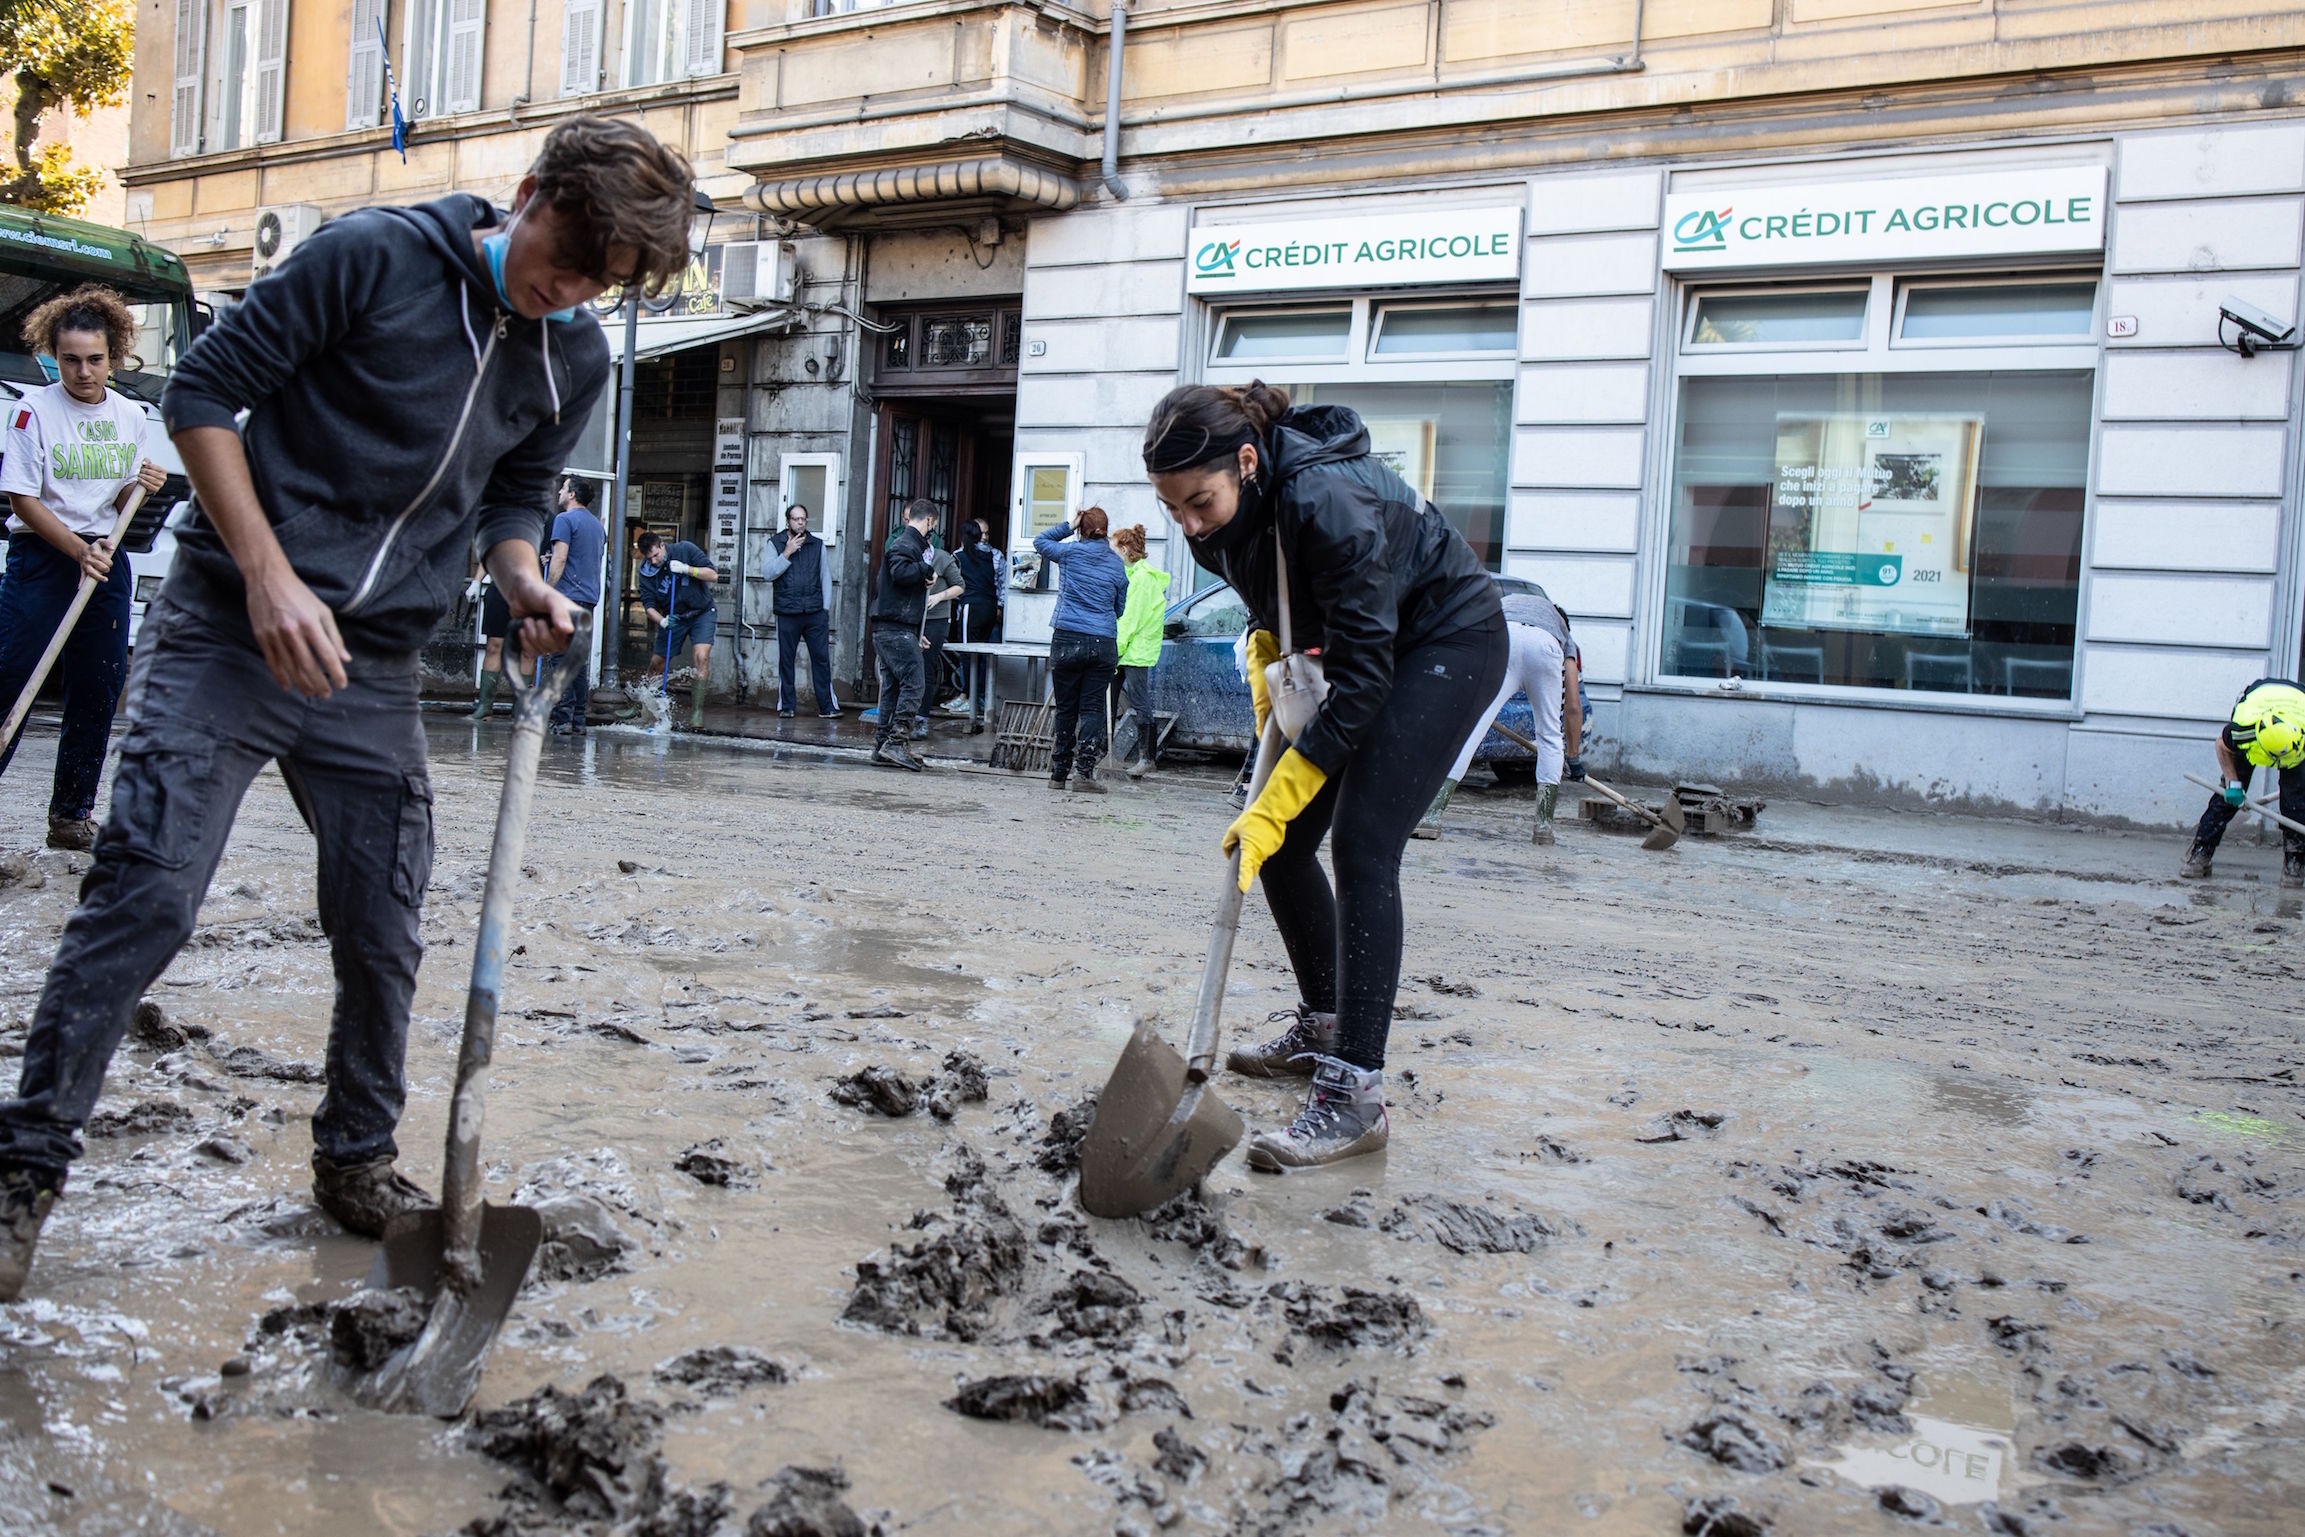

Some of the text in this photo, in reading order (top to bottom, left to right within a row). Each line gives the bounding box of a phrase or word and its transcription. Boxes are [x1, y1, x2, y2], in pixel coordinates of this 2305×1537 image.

[1739, 207, 1877, 241] CRÉDIT
[1884, 197, 2092, 232] AGRICOLE
[1245, 240, 1349, 268] CRÉDIT
[1354, 233, 1509, 263] AGRICOLE
[1781, 465, 1815, 479] Scegli
[1818, 467, 1841, 480] oggi
[1856, 467, 1893, 479] Mutuo
[1780, 480, 1800, 491] che
[1803, 480, 1825, 492] inizi
[1840, 483, 1880, 494] pagare
[1779, 494, 1853, 508] dopo un anno
[1913, 569, 1941, 583] 2021
